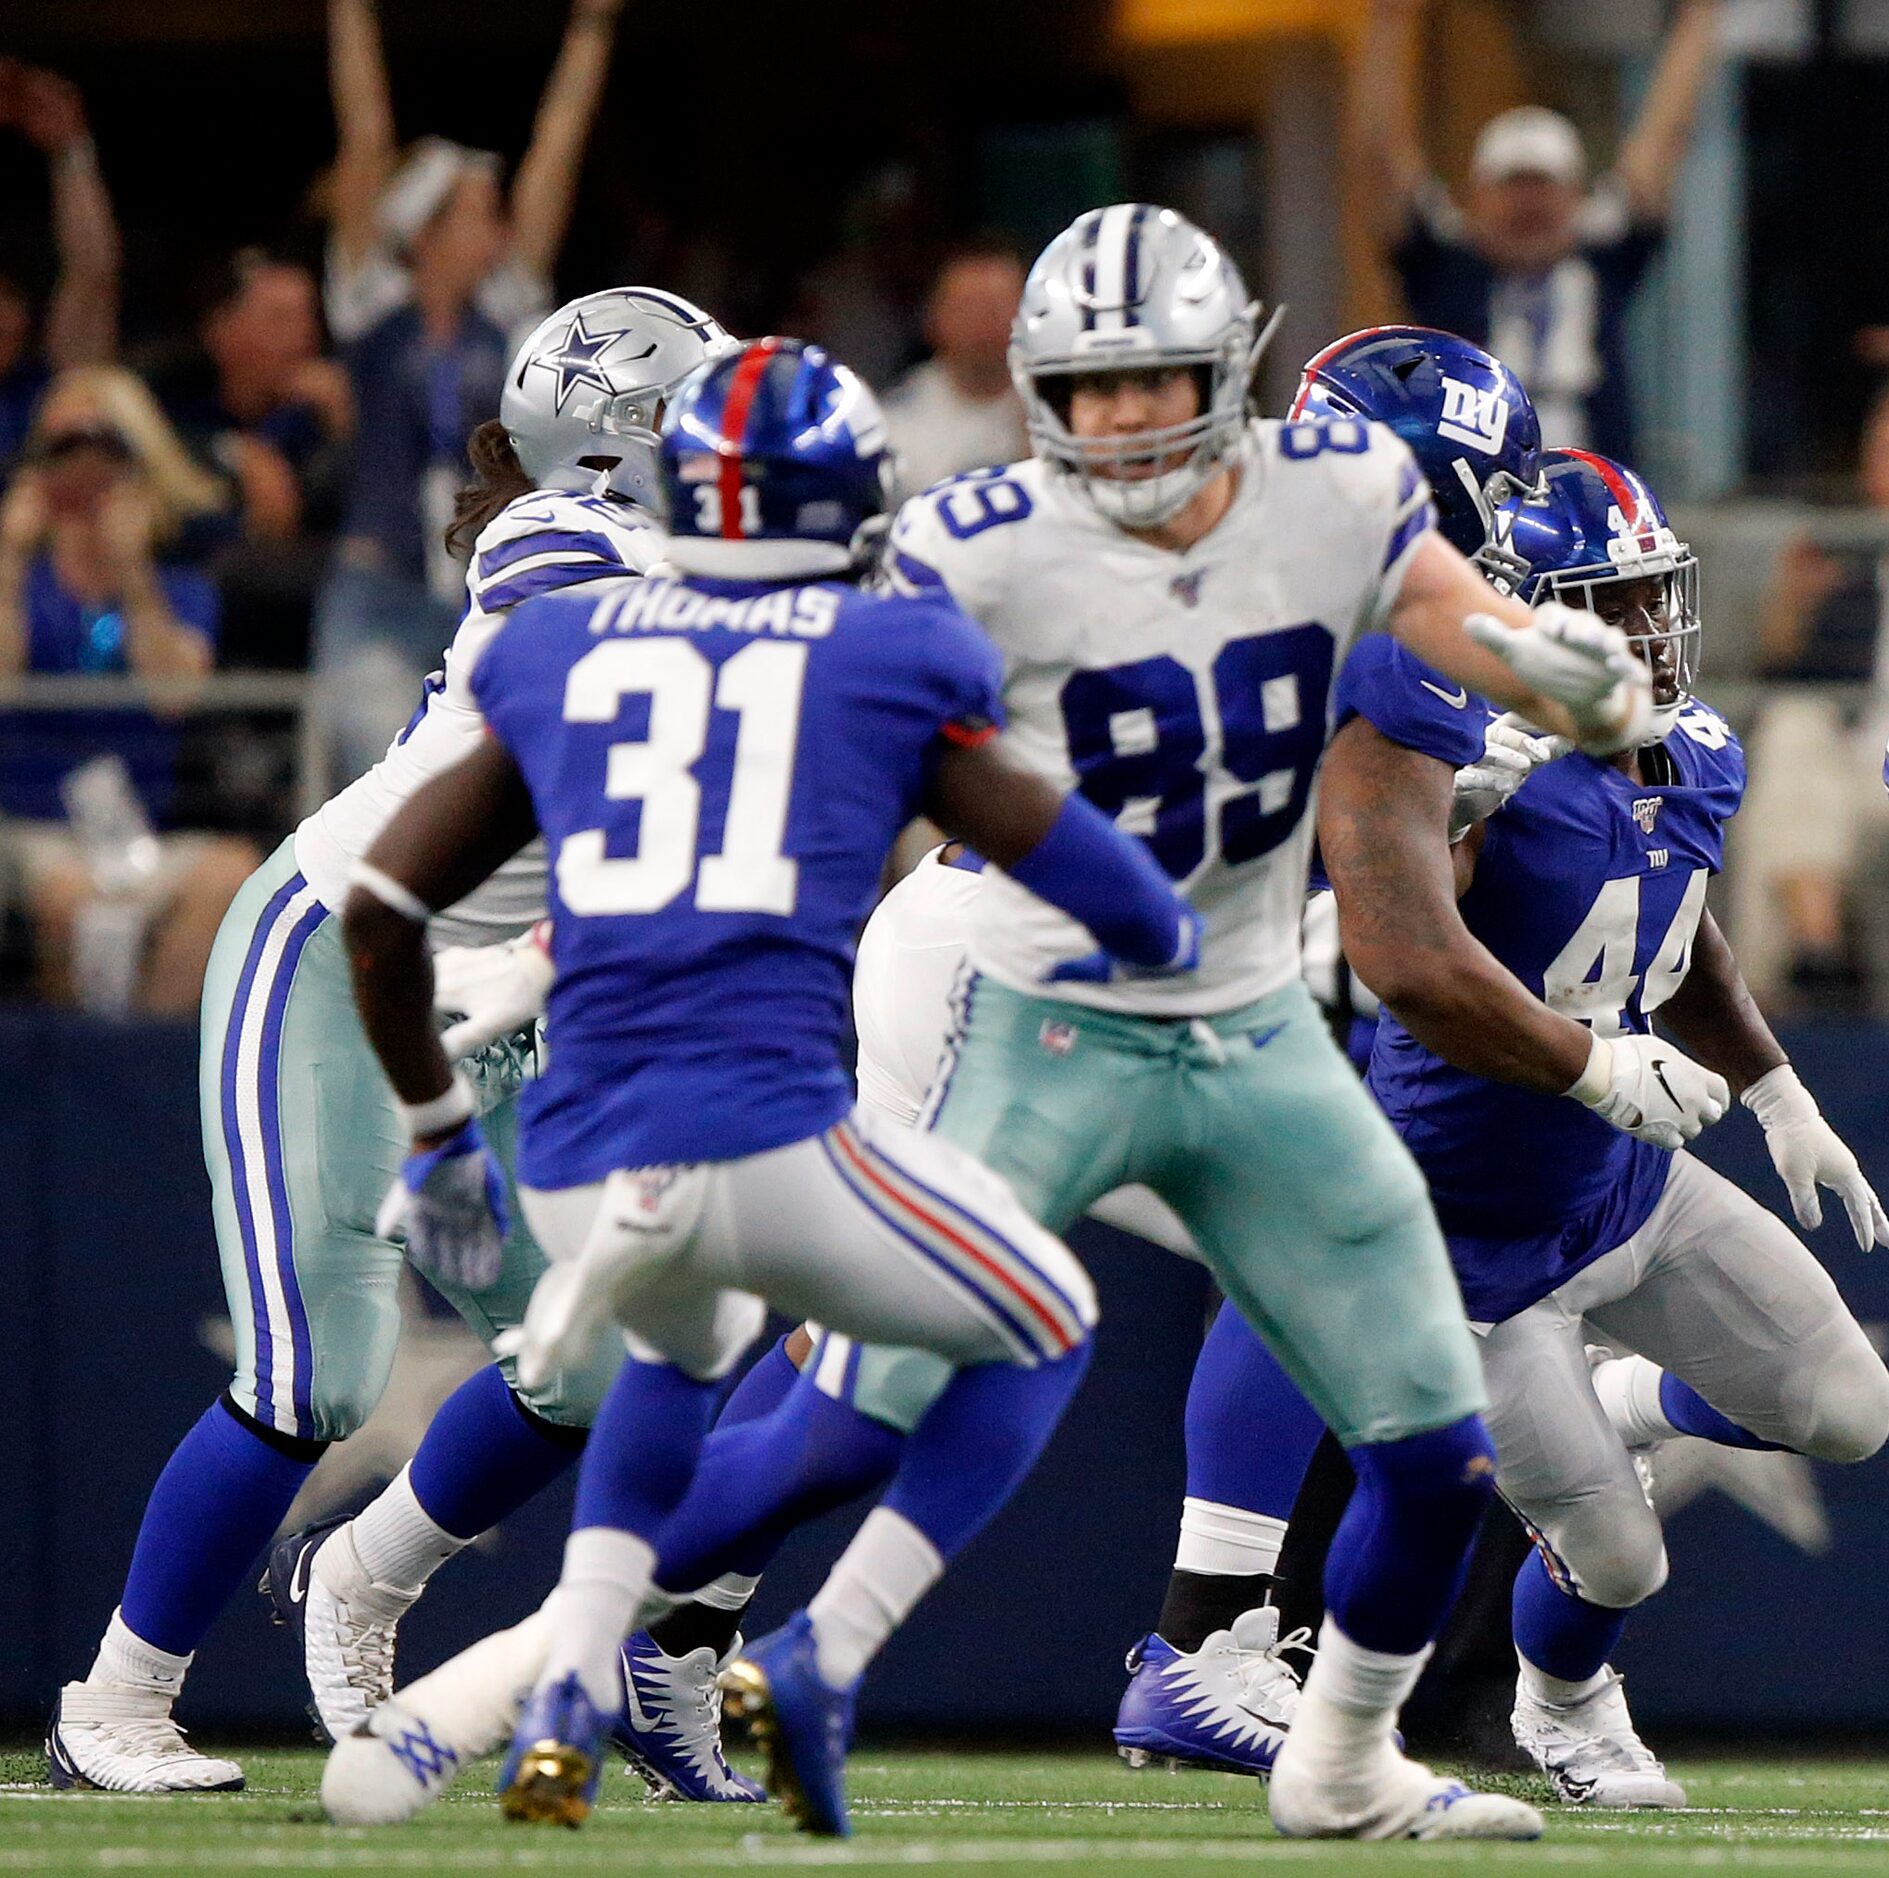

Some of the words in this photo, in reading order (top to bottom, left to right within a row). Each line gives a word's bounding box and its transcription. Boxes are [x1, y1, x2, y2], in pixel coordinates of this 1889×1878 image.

[587, 584, 840, 638] THOMAS
[556, 635, 808, 917] 31
[1059, 620, 1336, 893] 89
[1543, 868, 1710, 1036] 44
